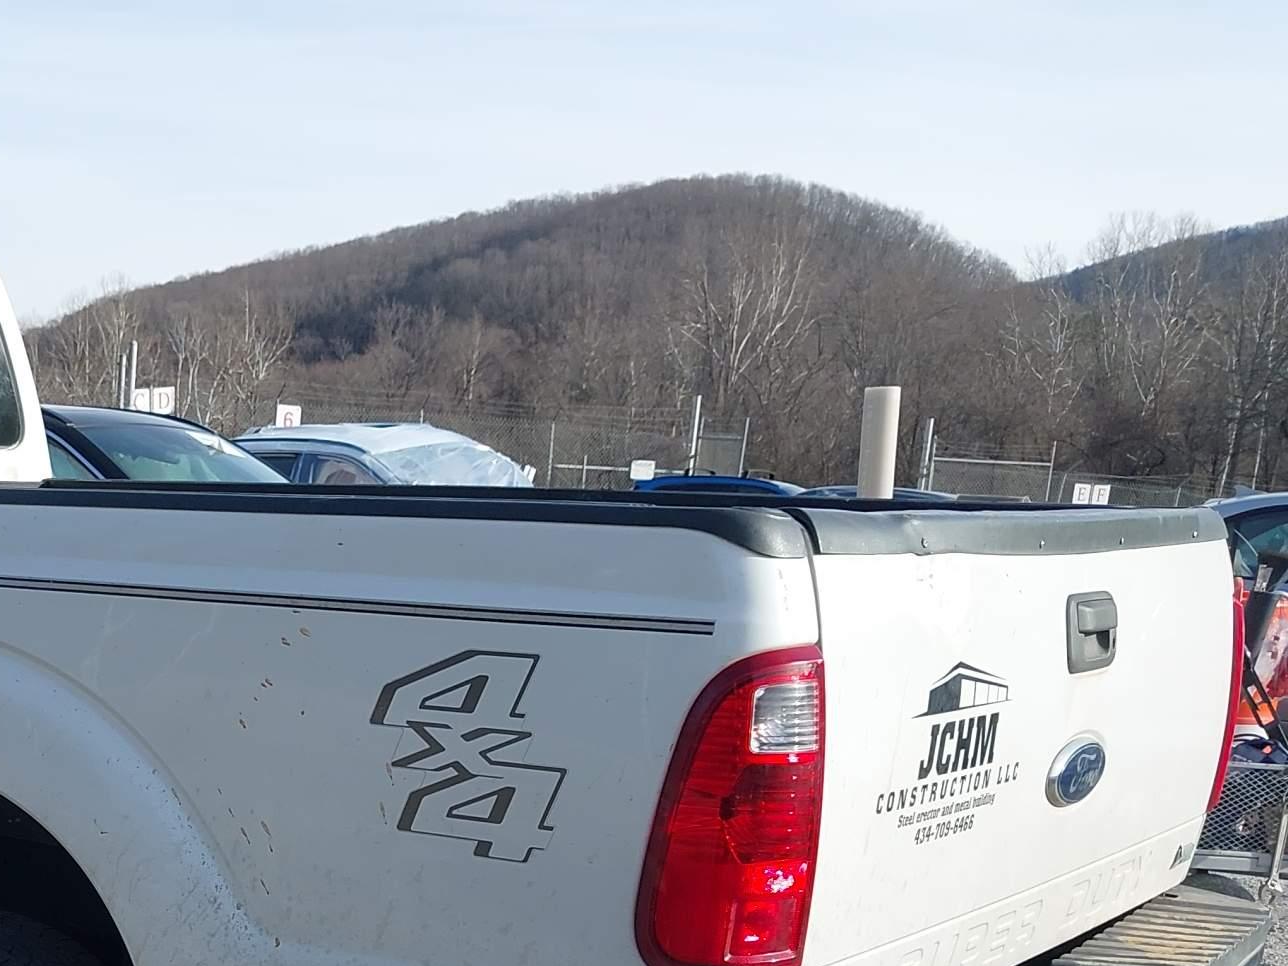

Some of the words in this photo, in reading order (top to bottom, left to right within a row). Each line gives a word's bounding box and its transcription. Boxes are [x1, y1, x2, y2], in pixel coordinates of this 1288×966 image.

[158, 391, 170, 409] D
[283, 412, 294, 428] 6
[1077, 487, 1087, 502] E
[917, 711, 1000, 781] JCHM
[875, 768, 992, 815] CONSTRUCTION
[996, 761, 1020, 785] LLC
[1069, 752, 1099, 793] Ford
[897, 811, 916, 829] Steel
[916, 807, 941, 824] erector
[941, 801, 955, 817] and
[954, 796, 972, 814] metal
[972, 792, 996, 809] building
[914, 814, 975, 846] 434-709-6466
